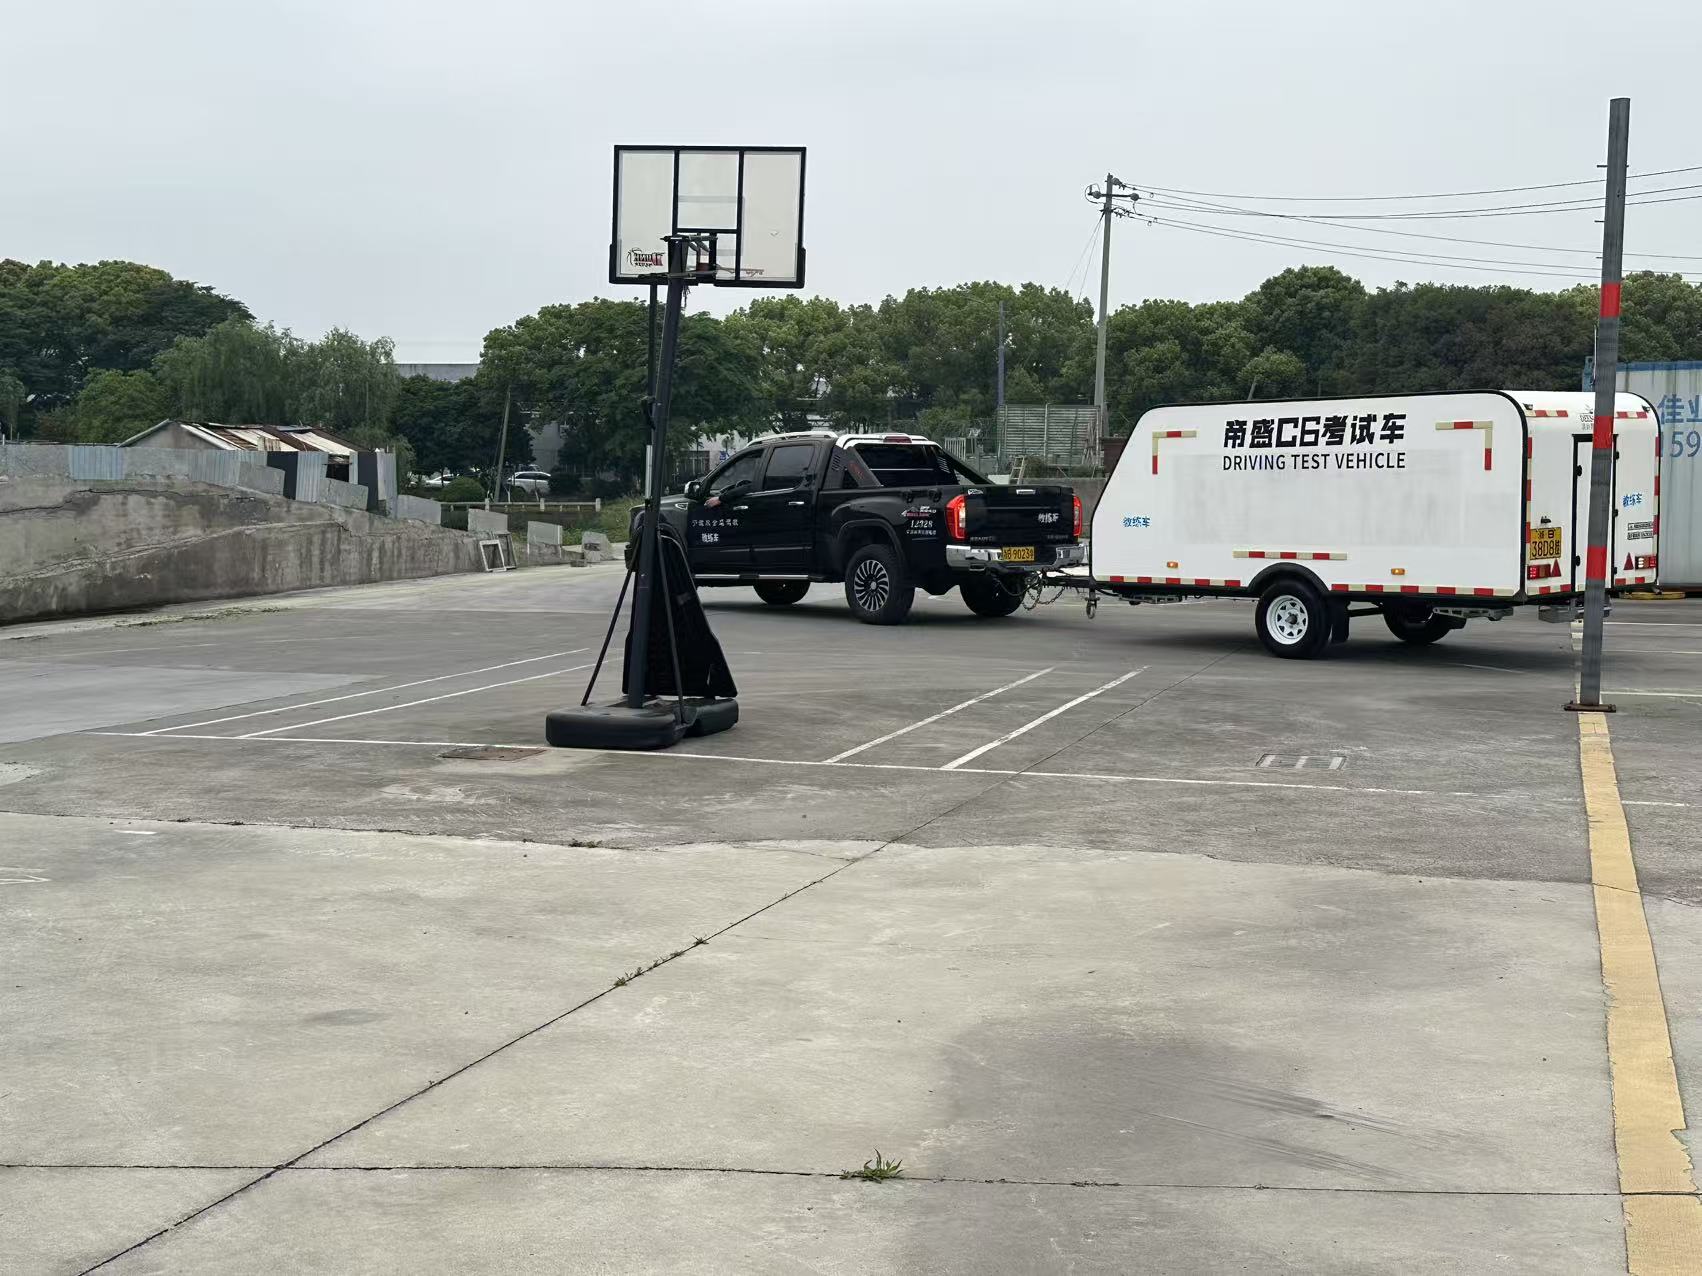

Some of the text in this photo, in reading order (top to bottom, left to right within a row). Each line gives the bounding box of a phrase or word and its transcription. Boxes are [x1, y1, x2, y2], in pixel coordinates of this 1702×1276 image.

[1224, 412, 1407, 449] 帝盛C6考试车
[1223, 452, 1406, 471] DRIVING TEST VEHICLE
[1122, 516, 1151, 528] 教练车
